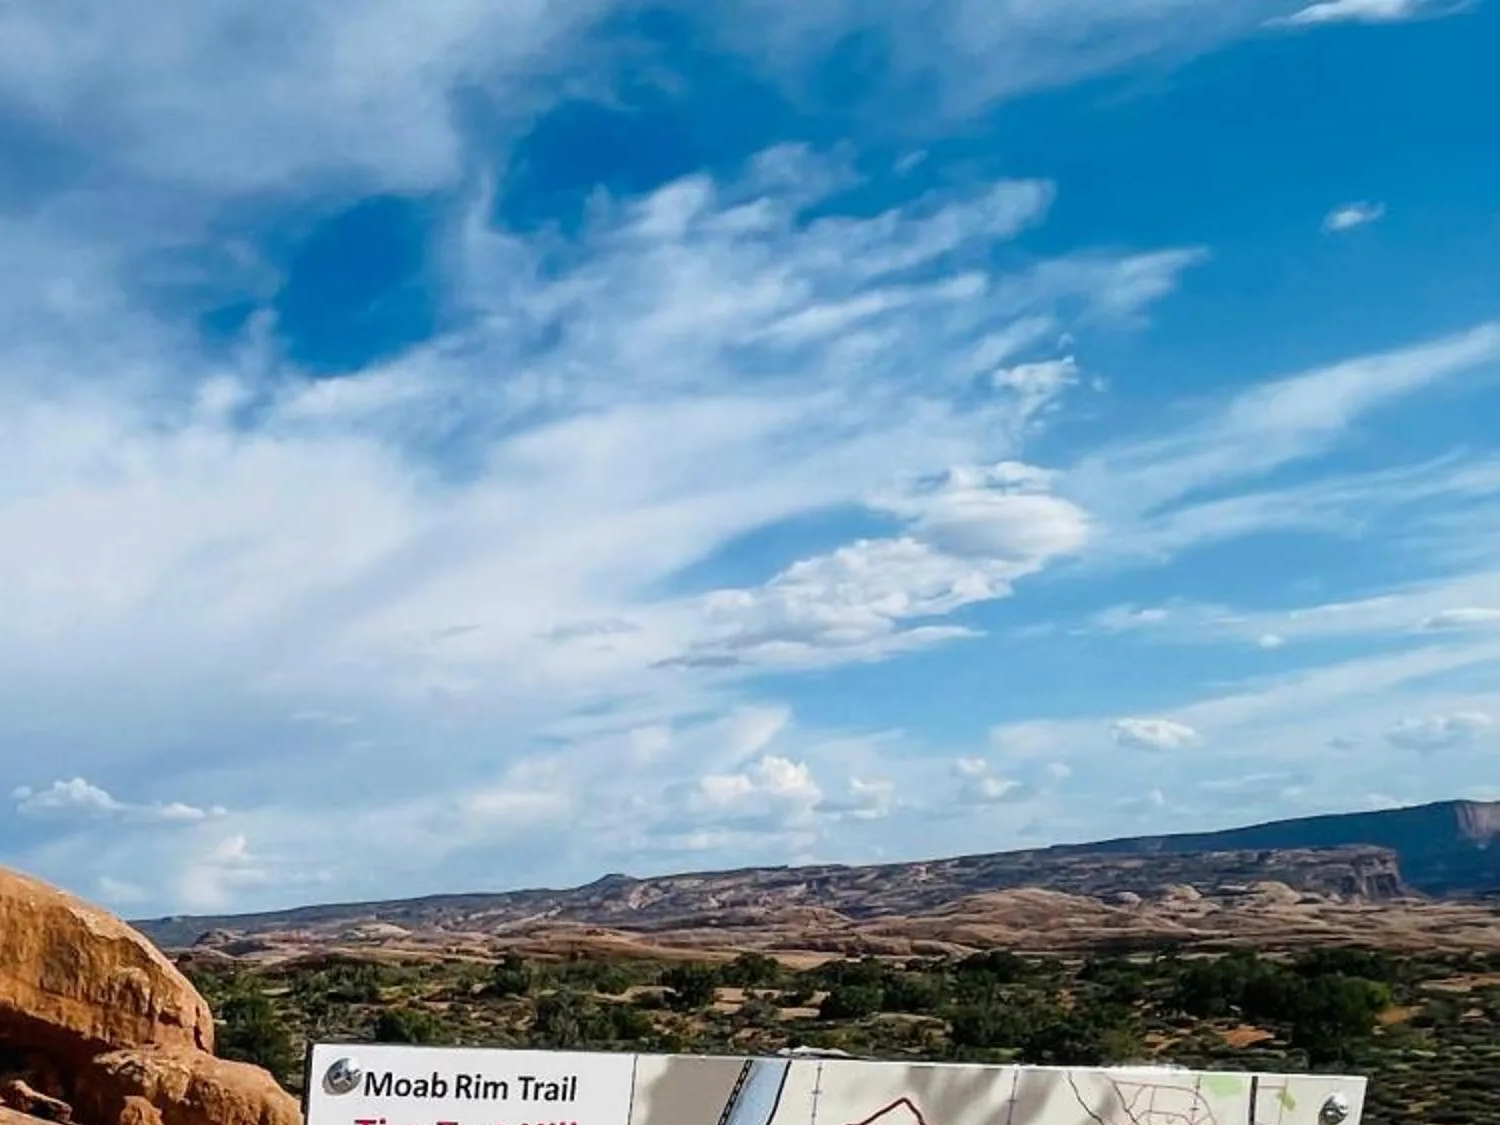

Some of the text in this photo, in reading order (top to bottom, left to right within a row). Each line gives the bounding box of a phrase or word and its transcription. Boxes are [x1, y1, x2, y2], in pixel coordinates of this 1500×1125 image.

[364, 1072, 577, 1102] Moab Rim Trail
